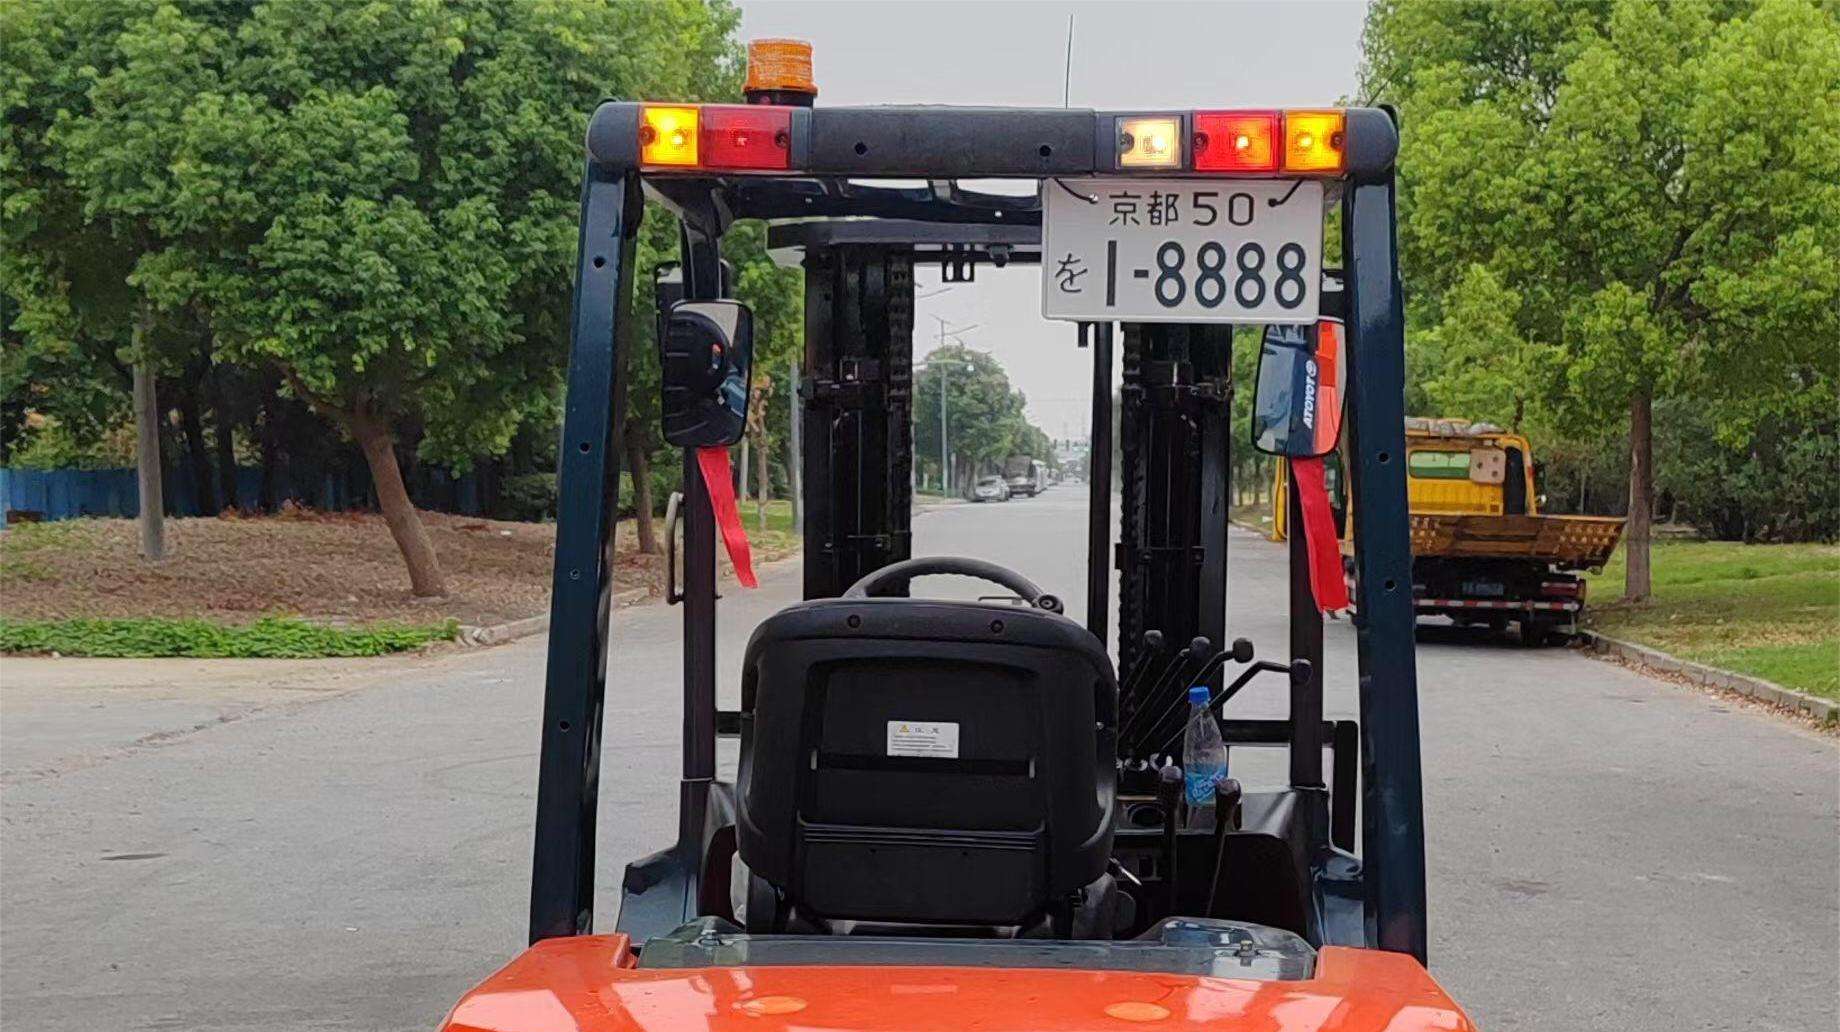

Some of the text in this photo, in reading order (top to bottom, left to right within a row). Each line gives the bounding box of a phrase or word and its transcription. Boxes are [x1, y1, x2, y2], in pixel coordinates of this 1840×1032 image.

[1108, 190, 1255, 227] 京都 50
[1055, 252, 1088, 294] を
